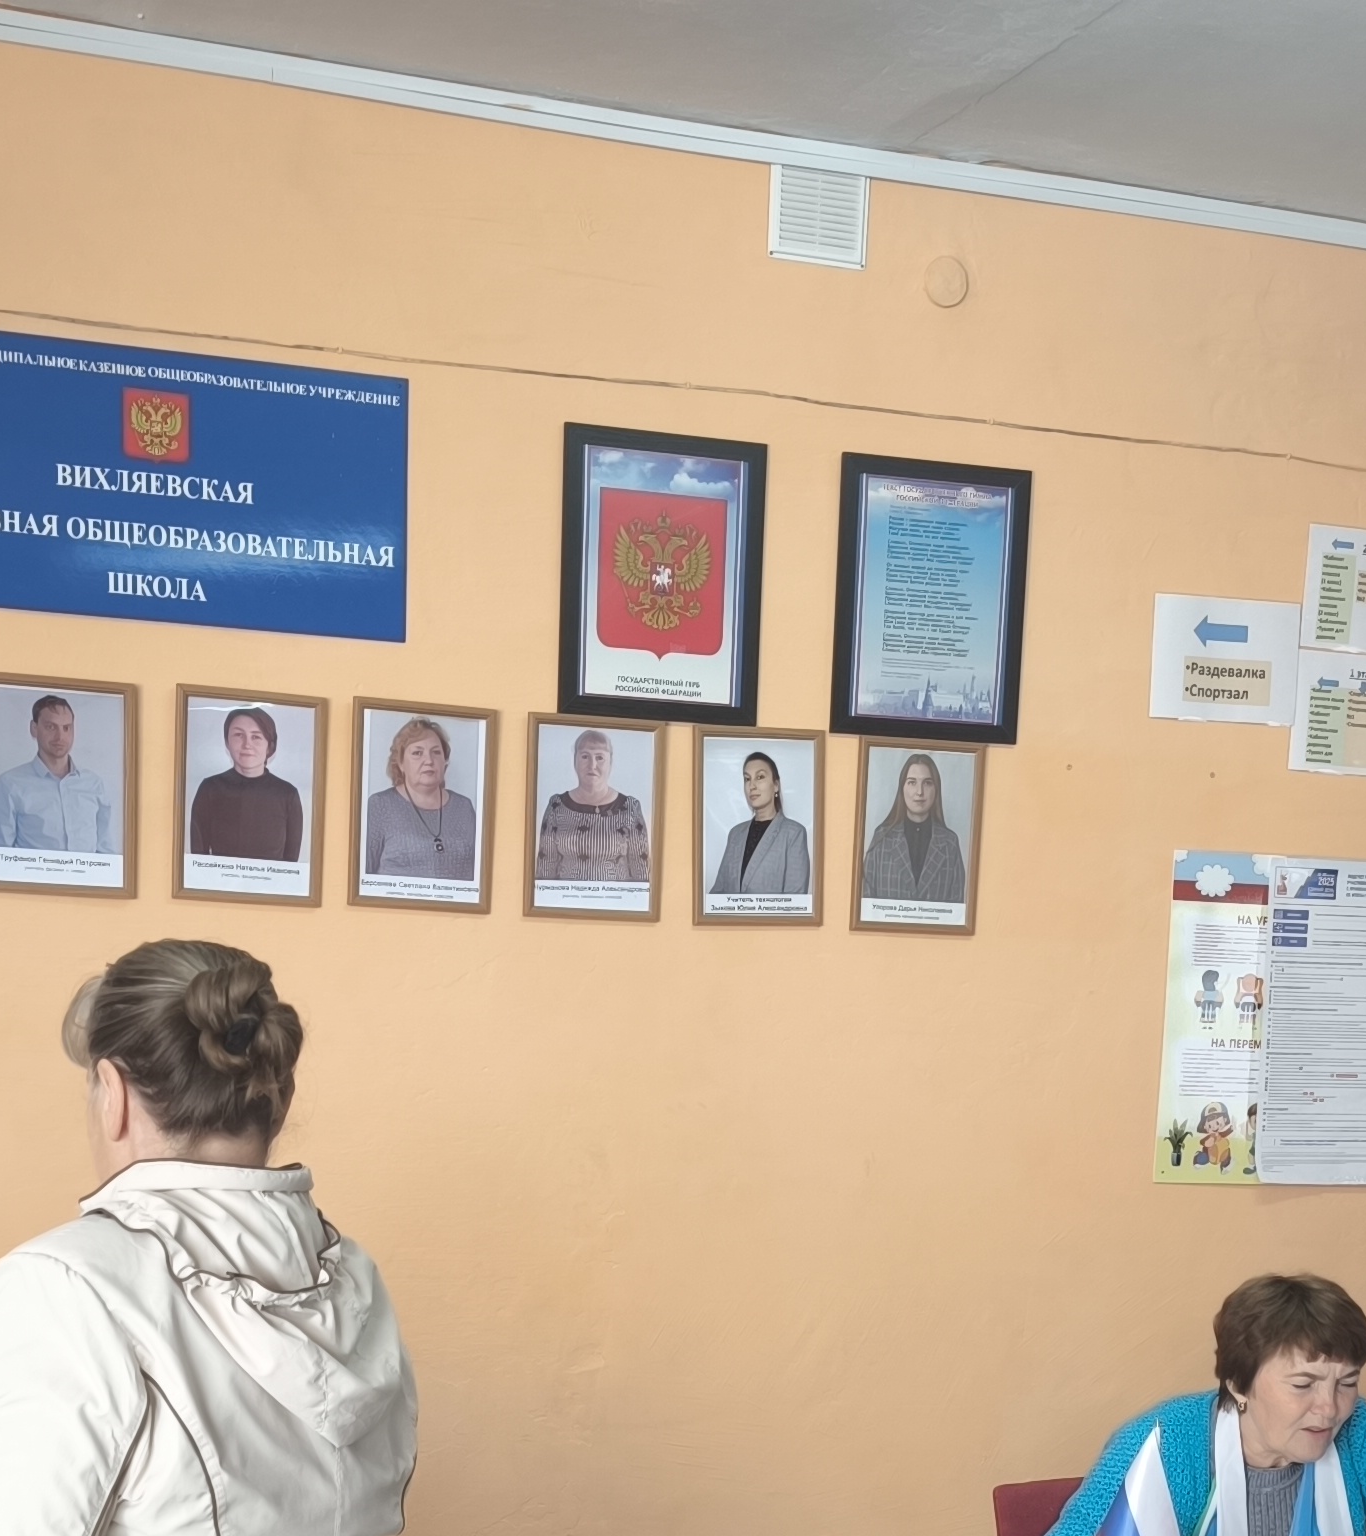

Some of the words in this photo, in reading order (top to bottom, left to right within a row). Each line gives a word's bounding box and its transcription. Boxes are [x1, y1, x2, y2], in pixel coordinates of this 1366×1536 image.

[79, 360, 146, 378] КАЗЕННОЕ
[148, 366, 307, 396] ОБЩЕОБРАЗОВАТЕЛЬНОЕ
[309, 384, 401, 407] УЧРЕЖДЕНИЕ
[55, 463, 254, 505] ВИХЛЯЕВСКАЯ
[66, 516, 395, 568] ОБЩЕОБРАЗОВАТЕЛЬНАЯ
[107, 571, 208, 602] ШКОЛА
[1190, 662, 1266, 681] Раздевалка
[1189, 685, 1250, 704] Спортзал
[1237, 914, 1252, 925] НА
[1211, 1038, 1226, 1048] НА
[1229, 1038, 1262, 1049] ПЕРЕМ
